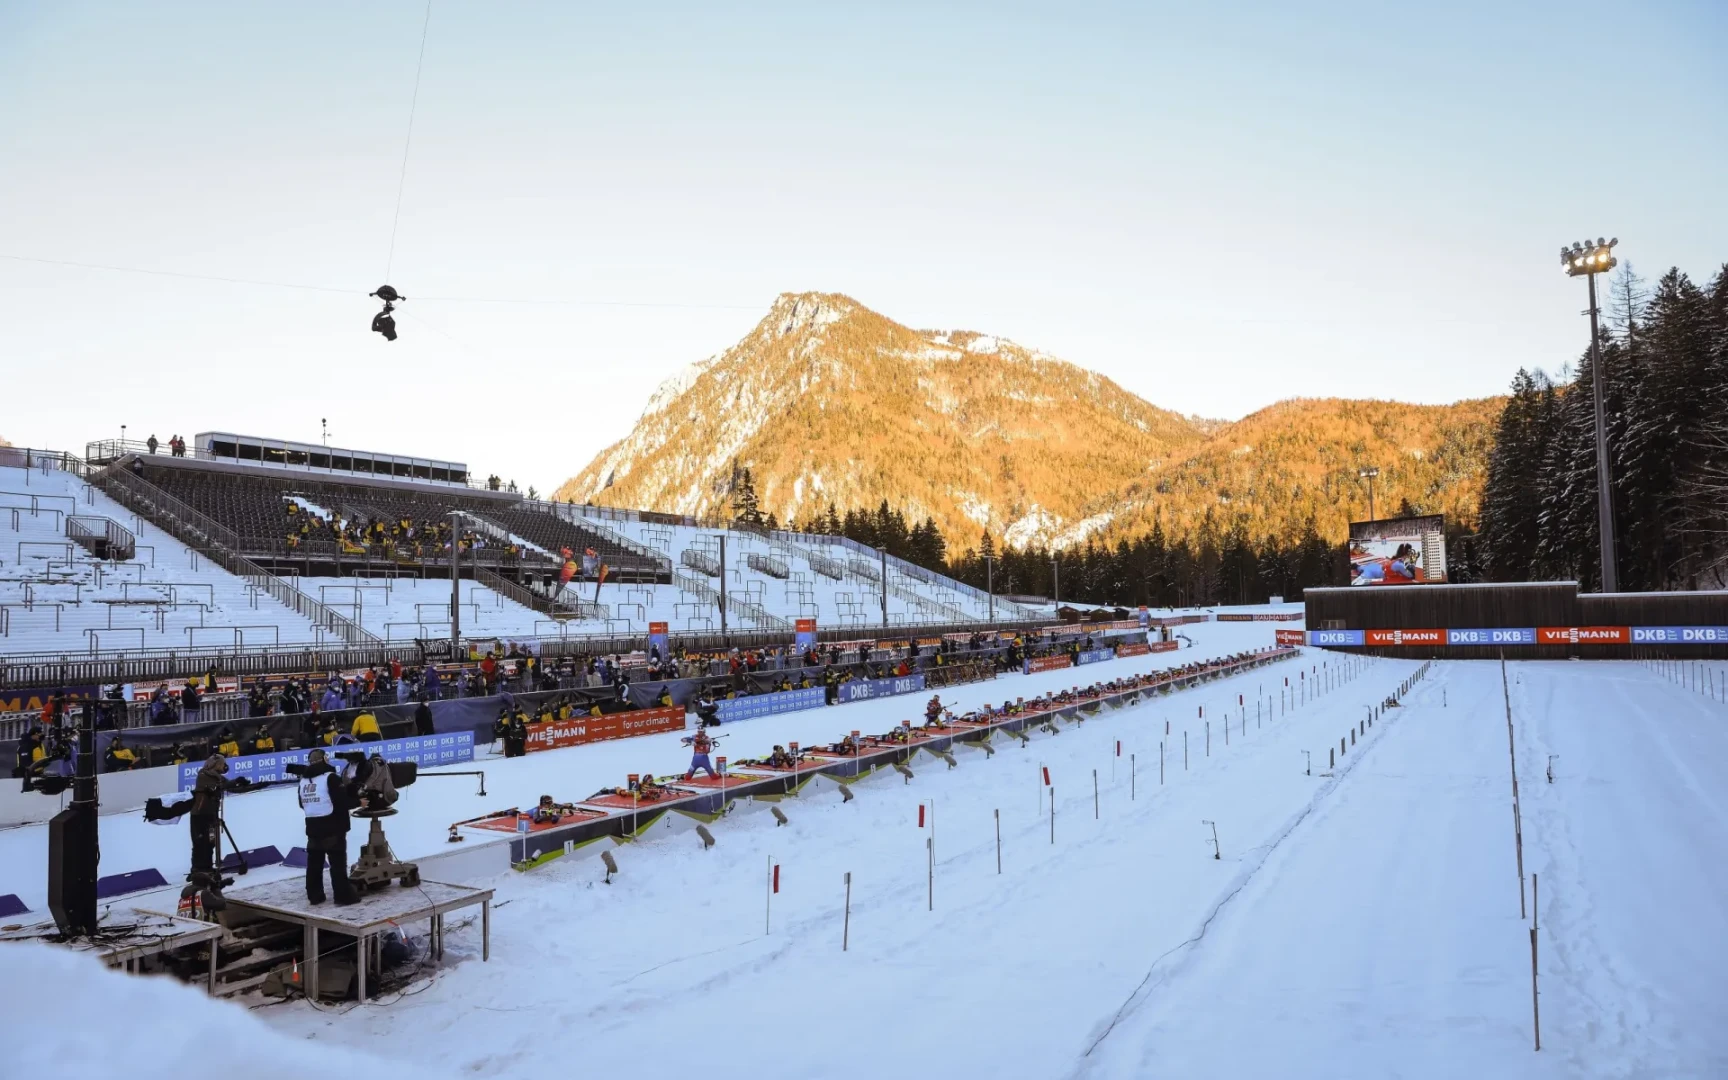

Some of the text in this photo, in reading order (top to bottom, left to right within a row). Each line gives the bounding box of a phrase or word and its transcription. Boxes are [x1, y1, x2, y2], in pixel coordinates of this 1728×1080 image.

[1320, 633, 1345, 643] DKB
[1373, 630, 1438, 644] VIESSMANN
[1451, 632, 1478, 642] DKB
[1493, 631, 1521, 641] DKB
[1546, 628, 1620, 643] VIESSMANN
[1634, 630, 1666, 640] DKB
[1683, 630, 1716, 640] DKB
[851, 684, 868, 699] DKB
[895, 679, 911, 692] DKB
[623, 720, 633, 729] for
[646, 717, 670, 726] climate
[528, 726, 585, 746] VIESSMANN
[185, 767, 202, 776] DK
[235, 761, 252, 770] DKB
[259, 758, 276, 767] DKB
[281, 756, 298, 764] DKB
[368, 745, 382, 754] DKB
[388, 743, 401, 751] DKB
[406, 741, 419, 750] DKB
[631, 781, 637, 790] 2
[666, 817, 671, 828] 2
